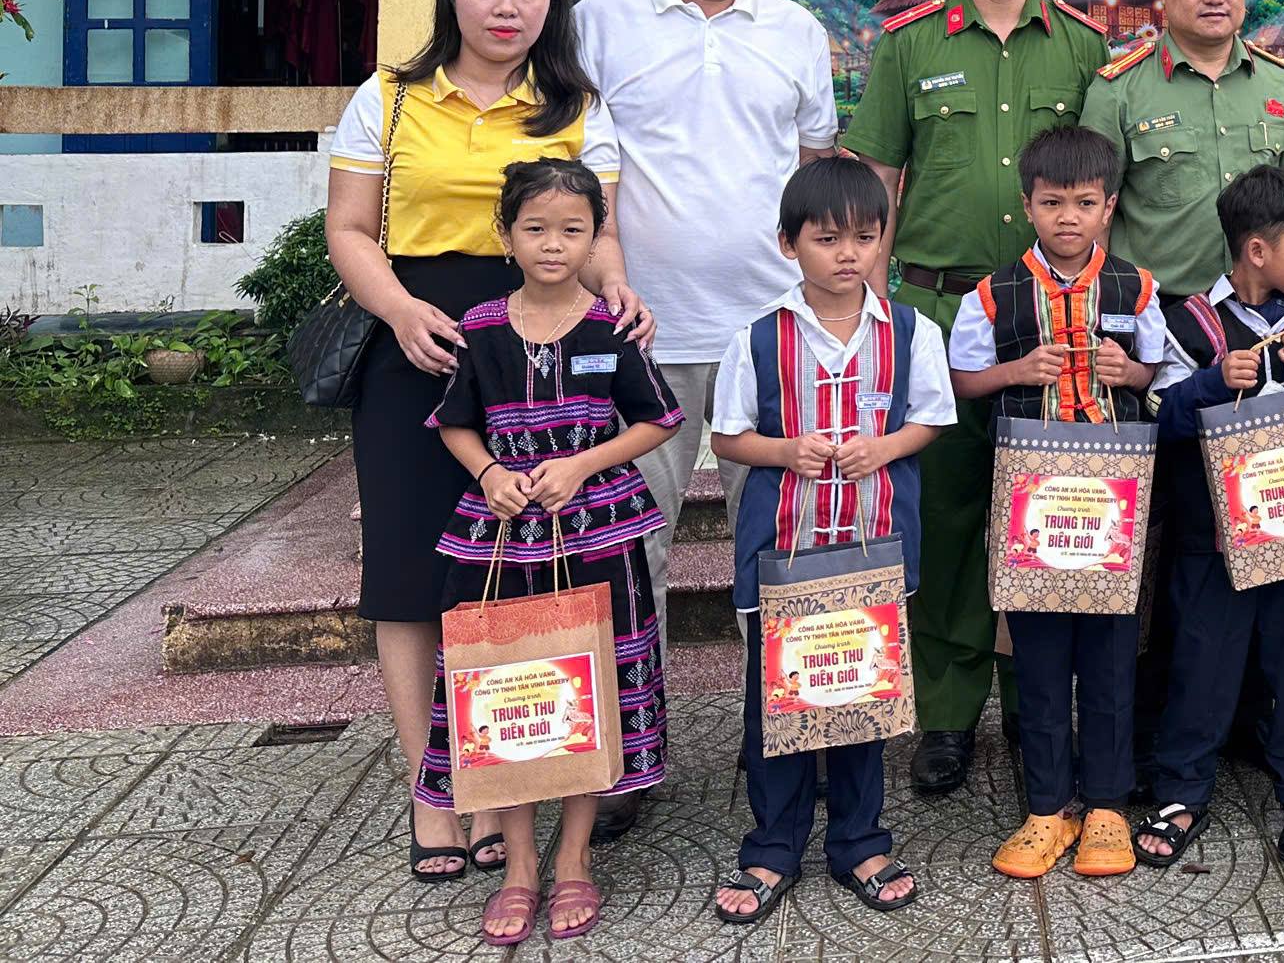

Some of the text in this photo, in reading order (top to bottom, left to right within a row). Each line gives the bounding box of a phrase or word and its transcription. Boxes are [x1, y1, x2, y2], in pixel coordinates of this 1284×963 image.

[1045, 515, 1100, 530] TRUNG THU
[1048, 533, 1094, 549] BIÊN GIỚI
[802, 649, 863, 669] TRUNG THU
[810, 667, 858, 687] BIÊN GIỚI
[492, 701, 555, 723] TRUNG THU
[500, 724, 525, 741] BIÊN
[529, 719, 550, 737] GIỚI
